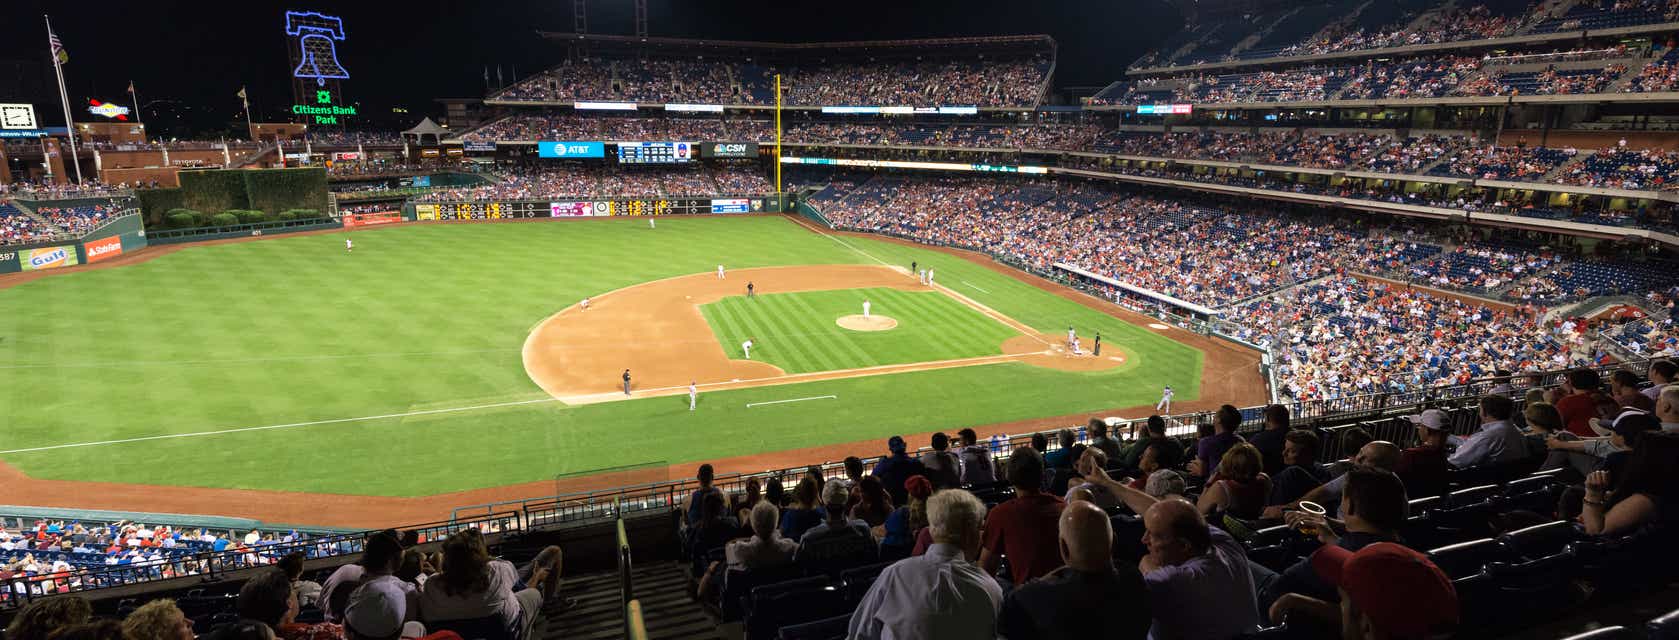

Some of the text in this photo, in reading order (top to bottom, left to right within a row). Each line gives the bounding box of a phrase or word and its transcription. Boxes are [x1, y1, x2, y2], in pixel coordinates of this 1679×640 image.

[293, 105, 356, 114] Citizens Bank
[316, 116, 337, 124] Park
[567, 145, 590, 154] AT&T
[726, 143, 747, 152] CSN
[31, 249, 65, 266] Gulf
